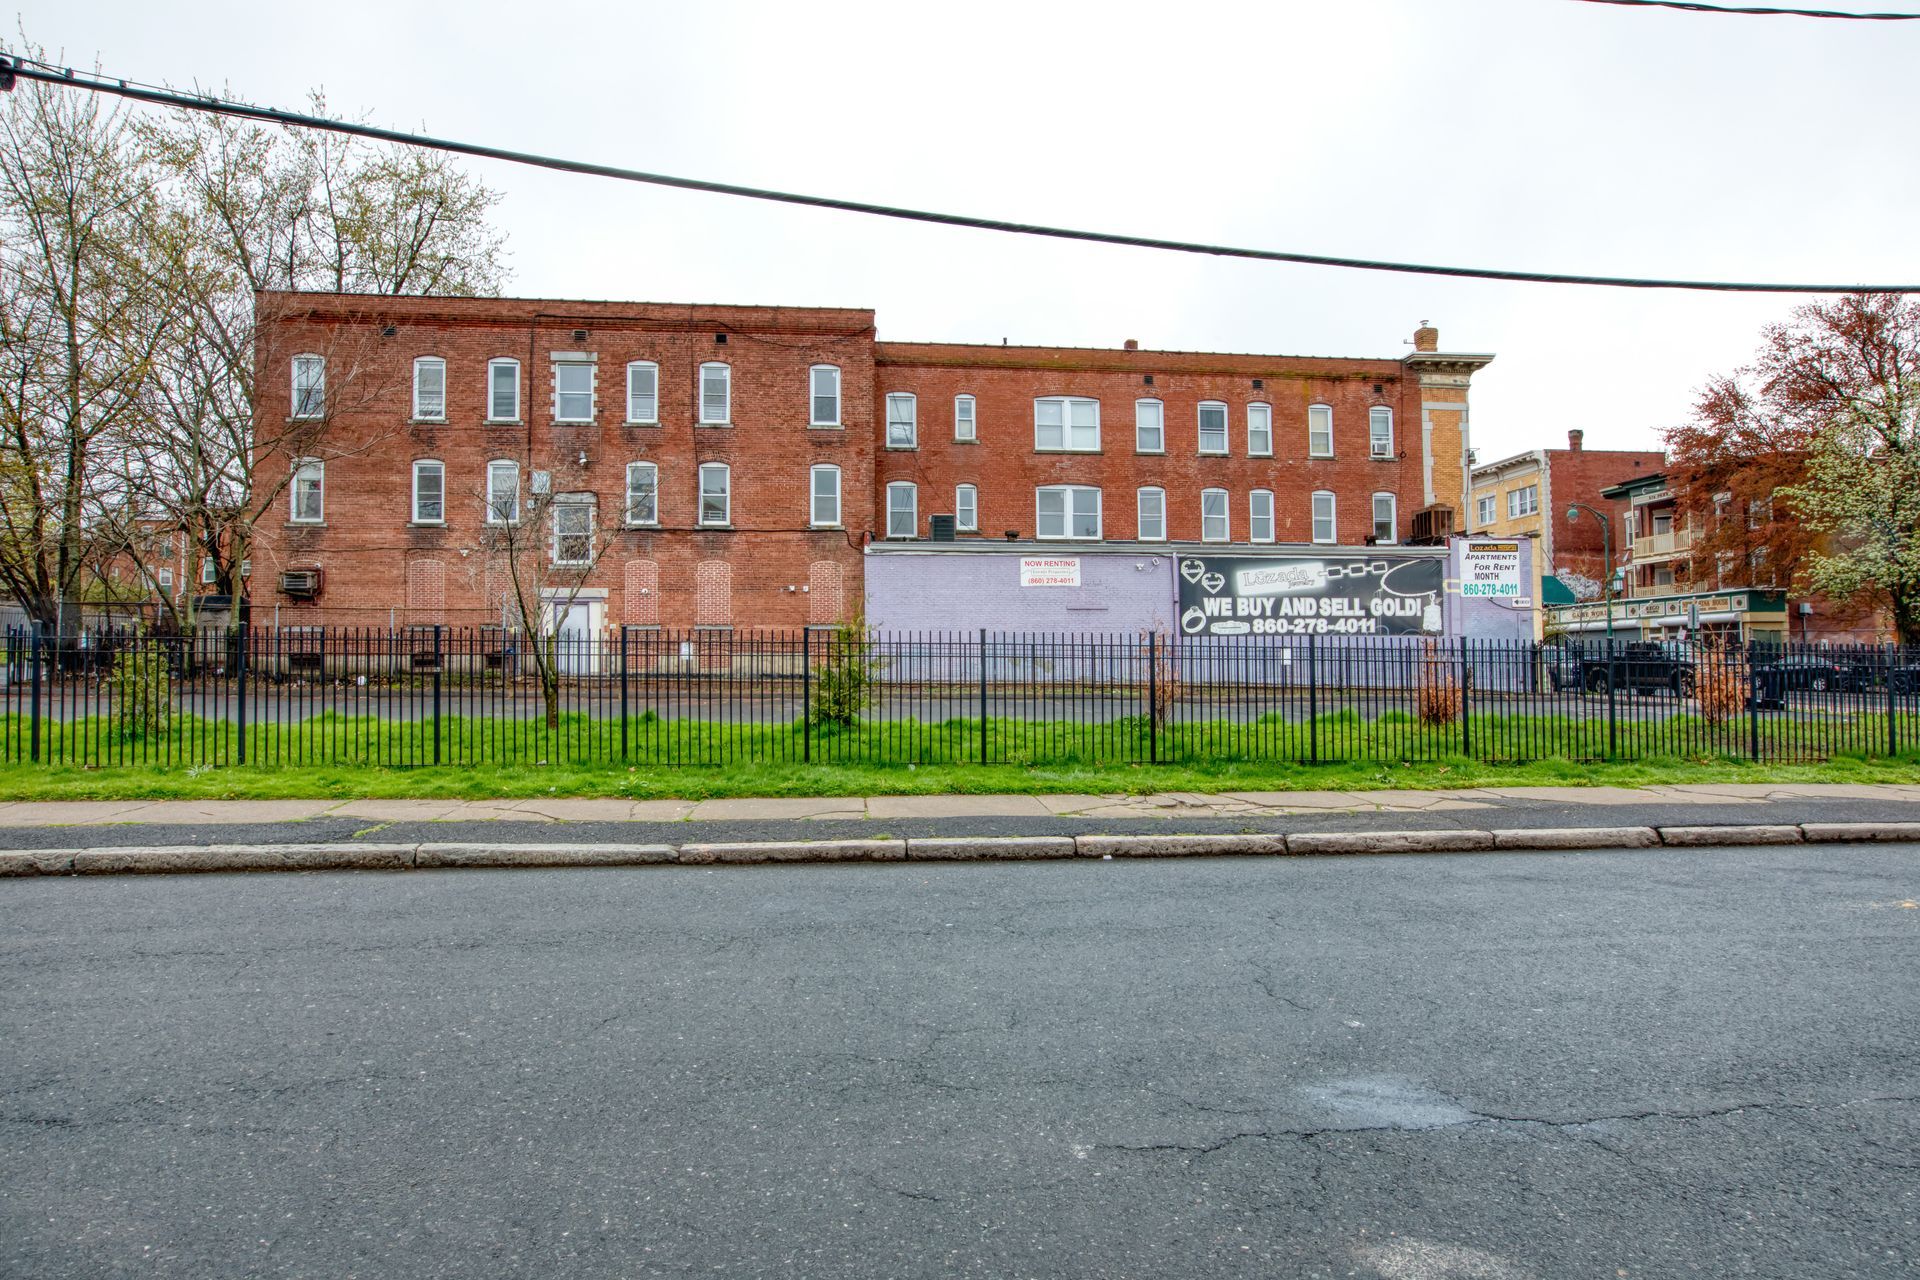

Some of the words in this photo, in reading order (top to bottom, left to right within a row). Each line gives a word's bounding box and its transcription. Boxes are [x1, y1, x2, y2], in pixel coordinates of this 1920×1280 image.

[1474, 563, 1491, 571] FOR
[1243, 567, 1310, 587] Lozada
[1464, 584, 1518, 595] 860-278-4011
[1203, 597, 1233, 616] WE
[1236, 597, 1276, 616] BUY
[1279, 597, 1317, 616] AND
[1319, 597, 1365, 616] SELL
[1370, 597, 1422, 616] GOLD!
[1252, 618, 1376, 633] 860-278-4011
